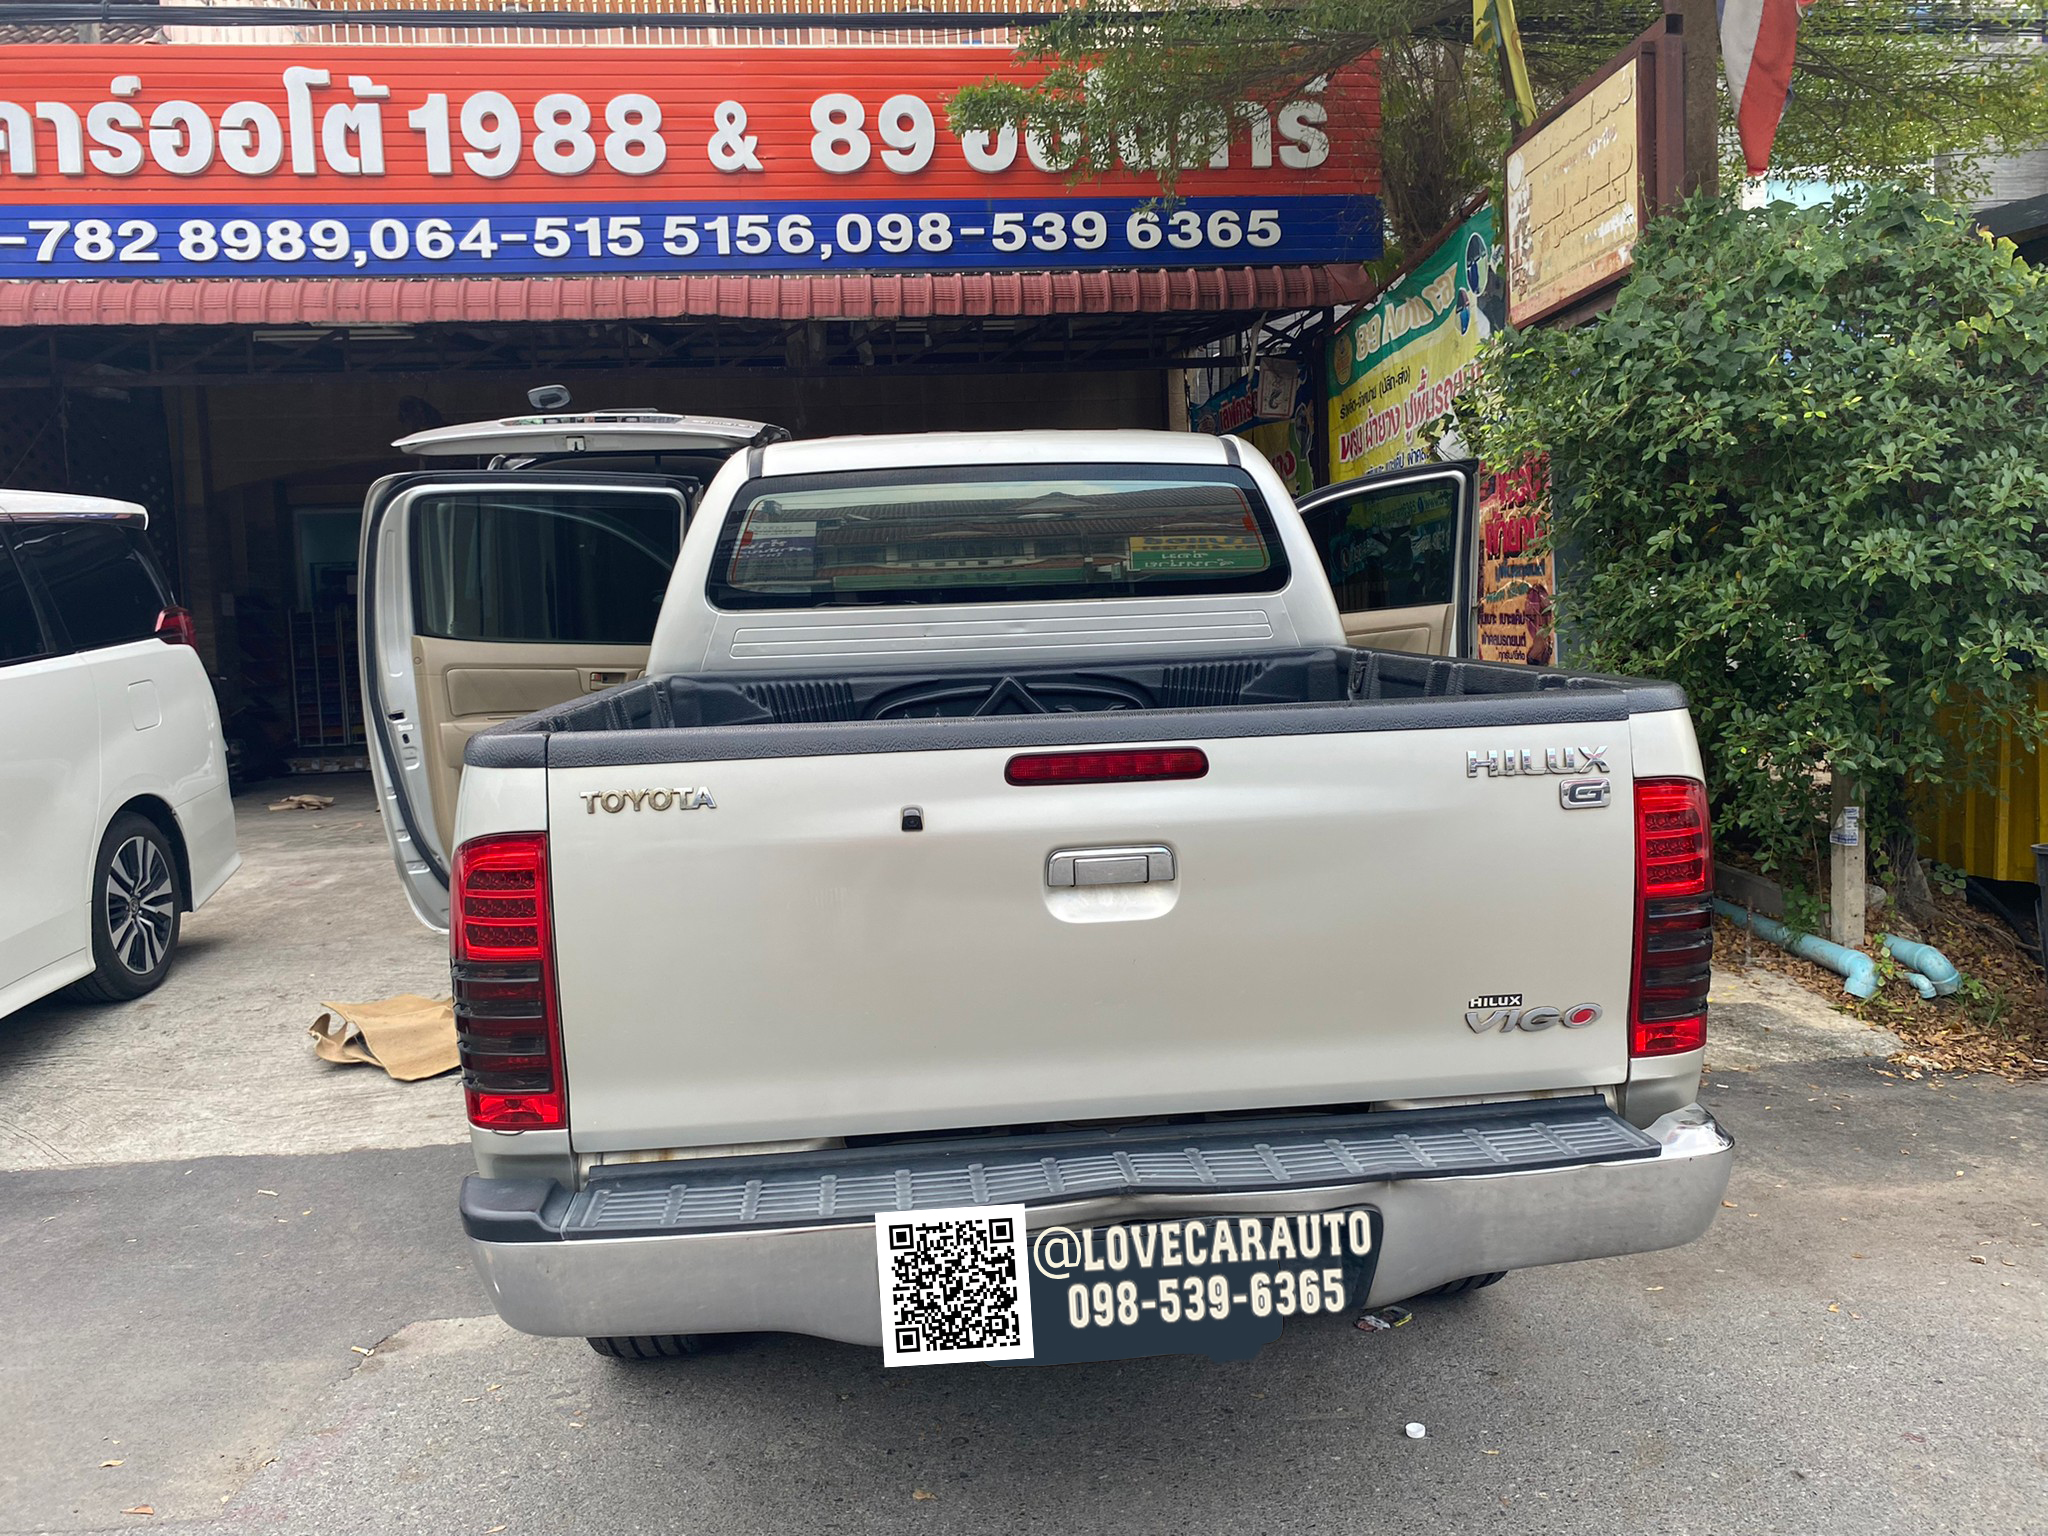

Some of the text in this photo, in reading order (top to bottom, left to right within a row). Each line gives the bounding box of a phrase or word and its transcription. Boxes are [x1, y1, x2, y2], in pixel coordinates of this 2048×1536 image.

[408, 91, 667, 178] 1988
[706, 100, 764, 173] &
[809, 92, 936, 175] 89
[177, 216, 645, 268] 8989,064-515
[662, 211, 1108, 260] 5156,098-539
[1125, 209, 1283, 249] 6365
[1355, 314, 1381, 361] 89
[1466, 745, 1611, 778] HILUX
[580, 786, 717, 814] TOYOTA
[1563, 779, 1609, 808] G
[1469, 994, 1522, 1009] HILUX
[1465, 1002, 1604, 1034] VIGO
